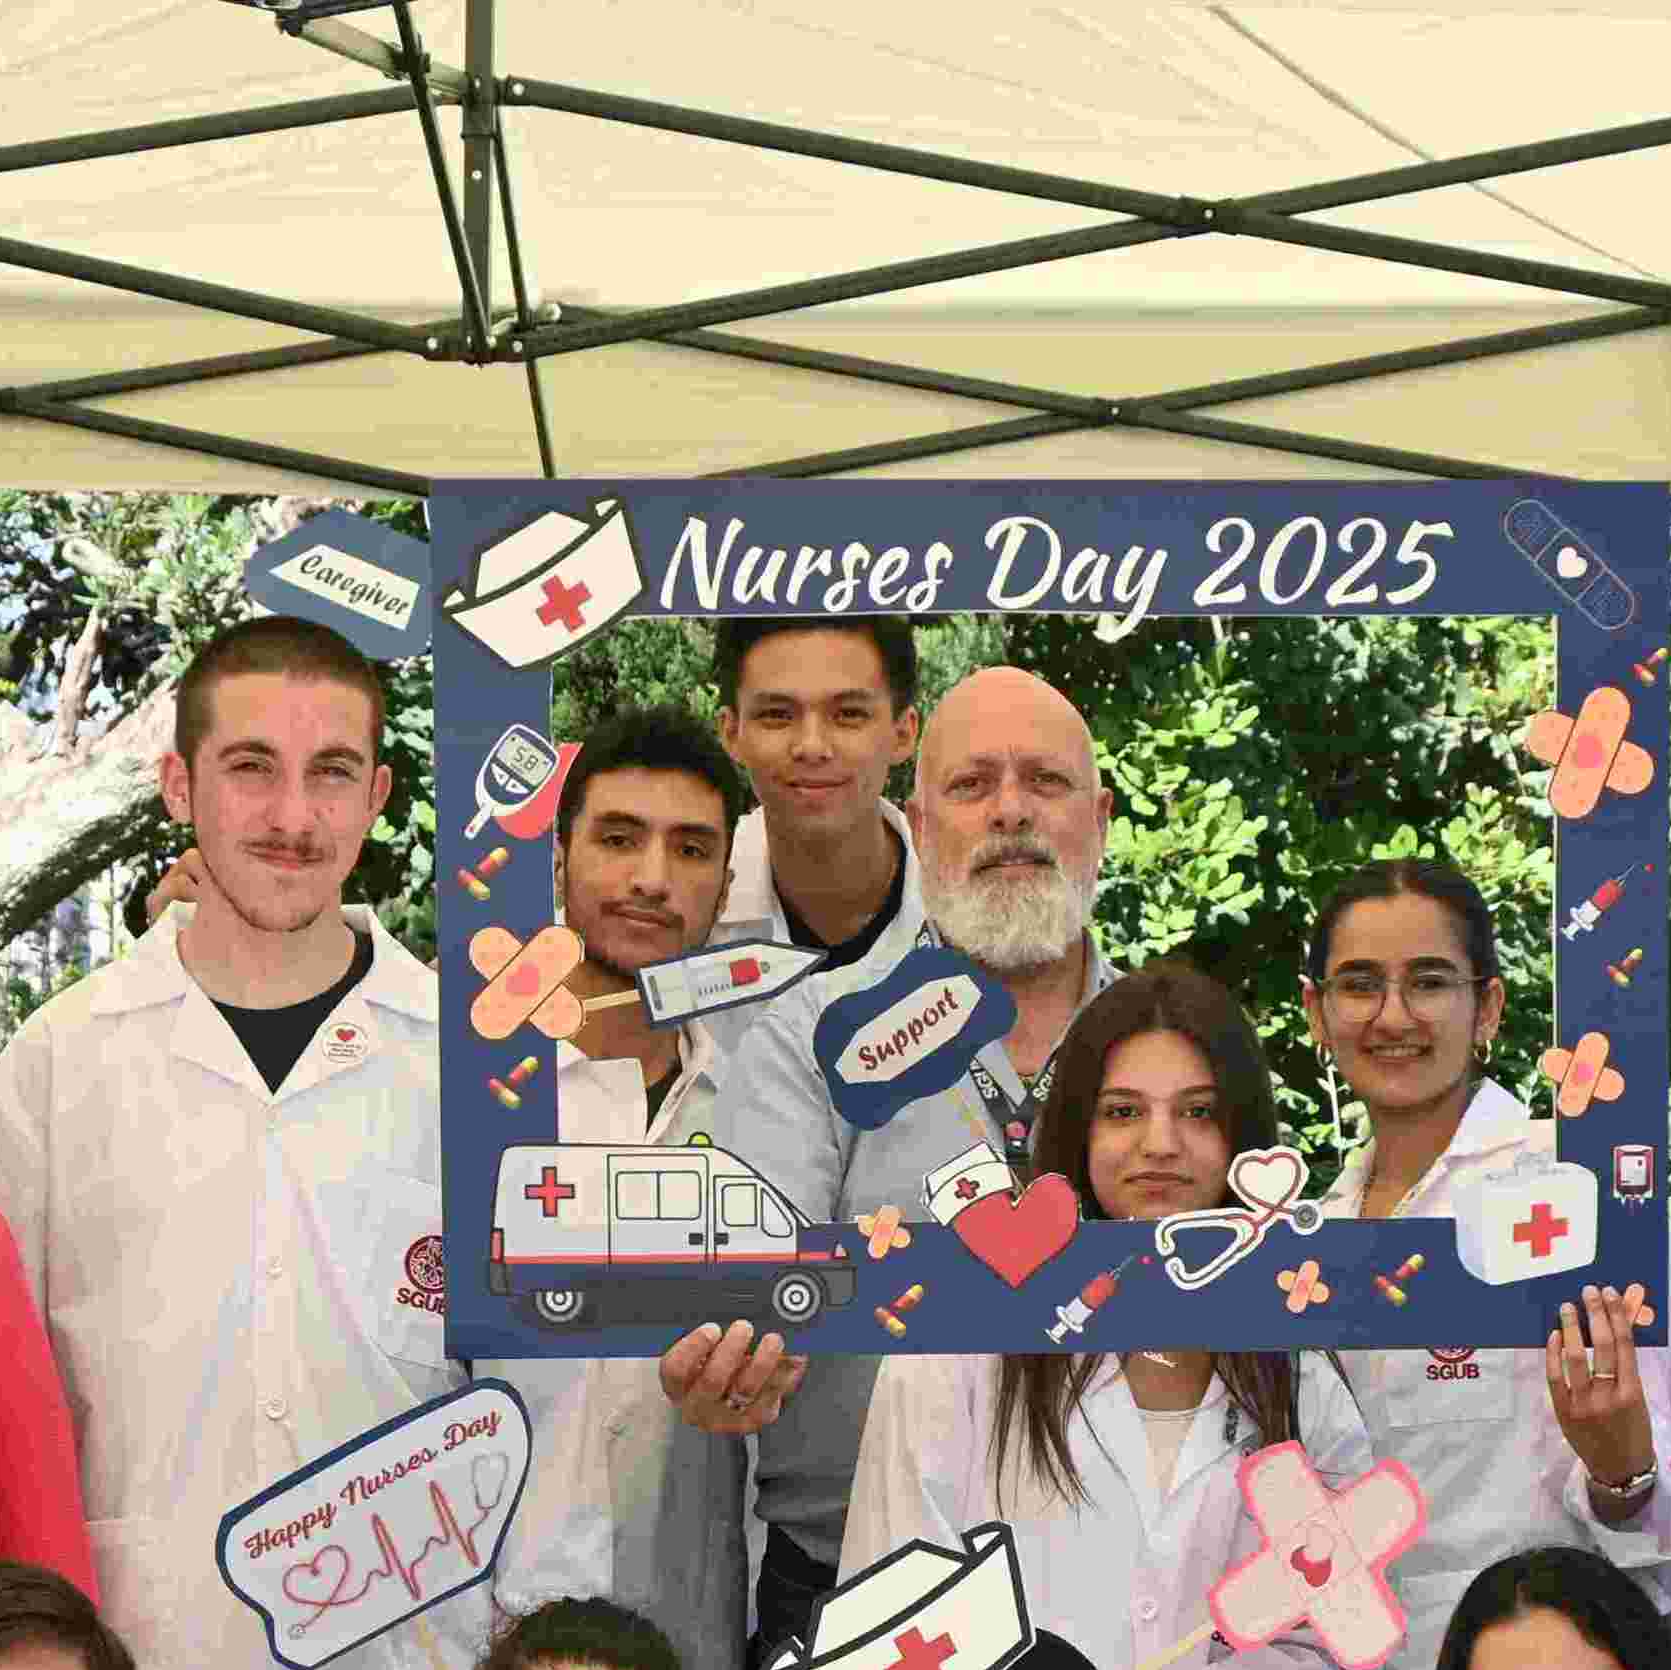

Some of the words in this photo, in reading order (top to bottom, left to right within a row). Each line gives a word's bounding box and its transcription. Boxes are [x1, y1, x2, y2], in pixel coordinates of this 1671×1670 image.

[299, 555, 410, 616] Caregiver
[659, 516, 954, 613] Nurses
[984, 515, 1169, 644] Day
[1192, 516, 1455, 608] 2025
[857, 985, 959, 1072] Support
[1425, 1363, 1480, 1381] SGUB
[243, 1502, 338, 1559] Happy
[339, 1447, 439, 1506] Nurses
[442, 1408, 502, 1450] Day
